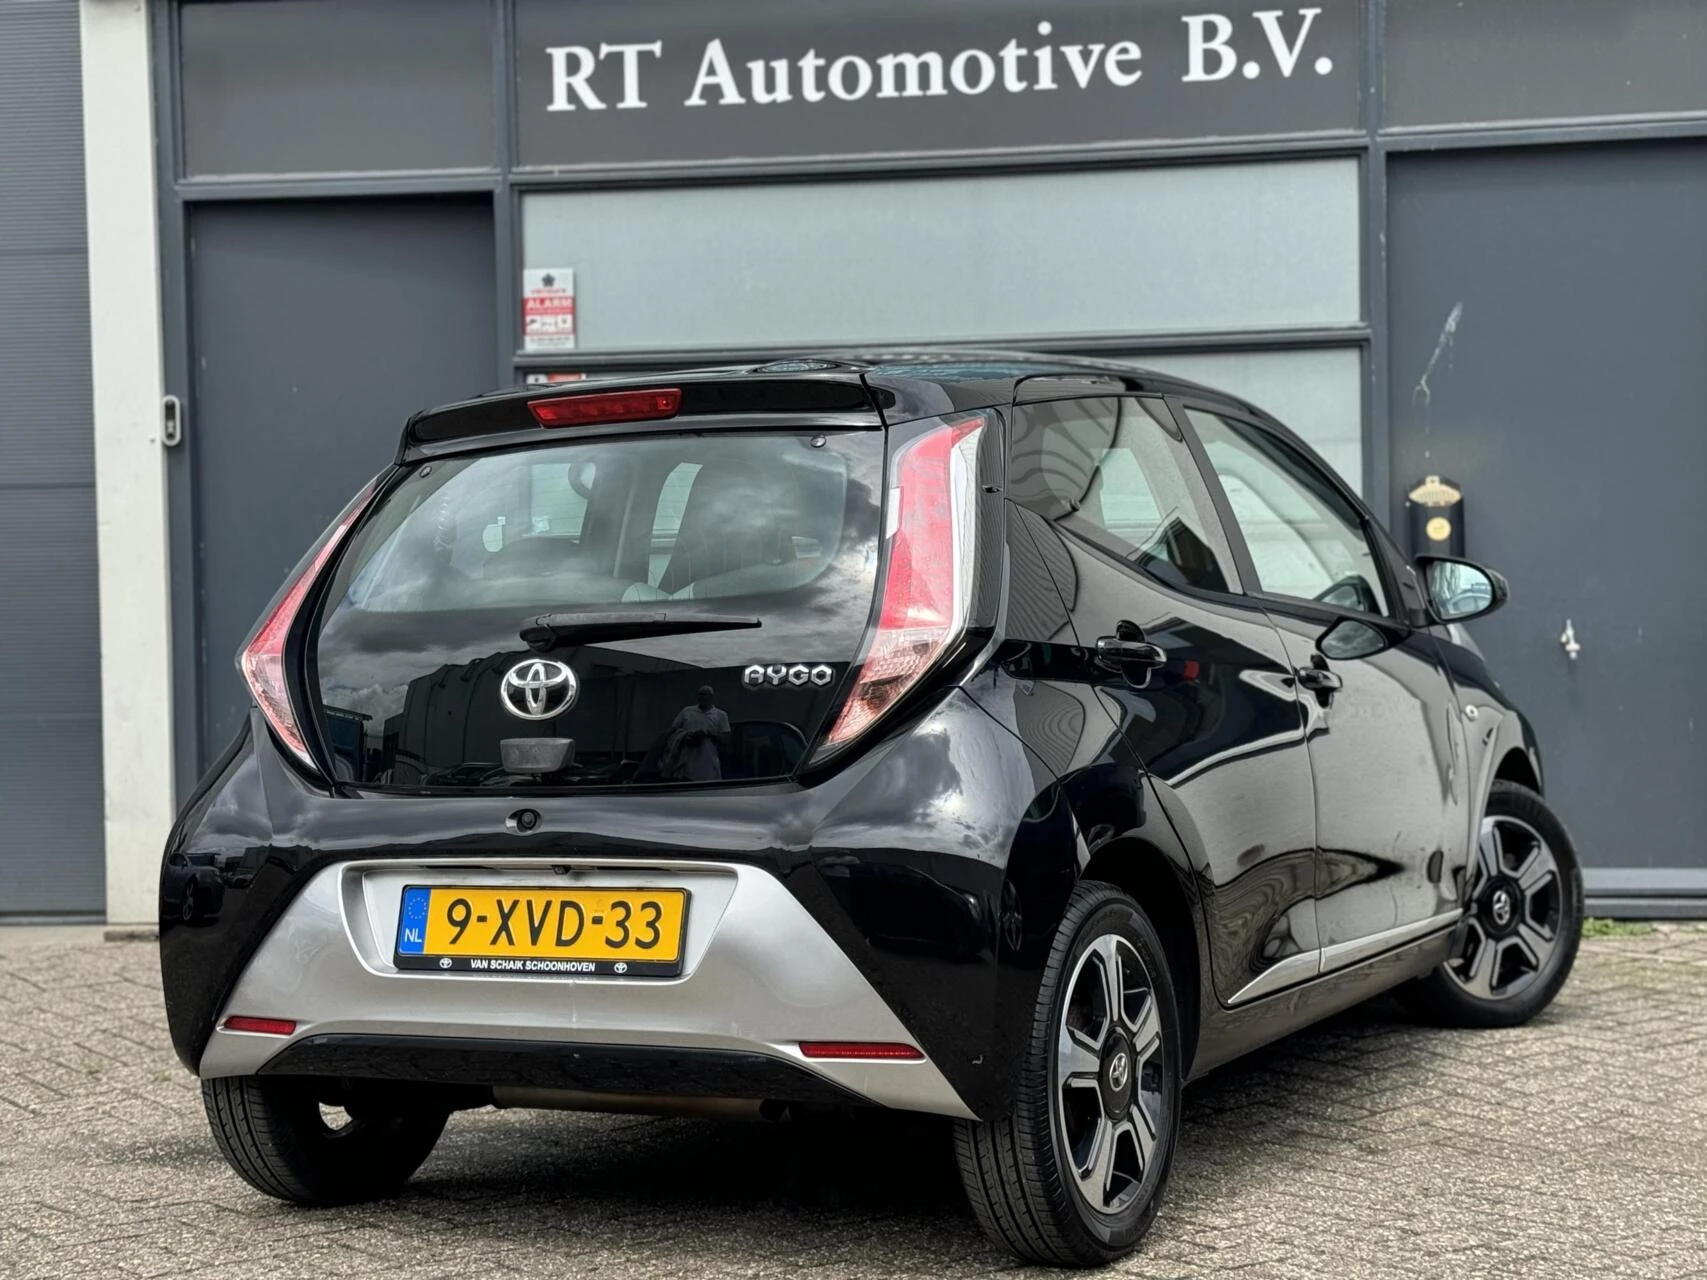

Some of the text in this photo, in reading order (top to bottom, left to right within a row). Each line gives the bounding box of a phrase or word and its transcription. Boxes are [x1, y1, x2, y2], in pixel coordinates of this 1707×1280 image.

[545, 7, 1333, 112] RT Automotive B.V.
[743, 663, 833, 687] AYGO
[403, 927, 423, 943] NL
[446, 897, 663, 950] 9-XVD-33
[470, 958, 596, 972] VAN SCHAIK SCHOONHOVEN
